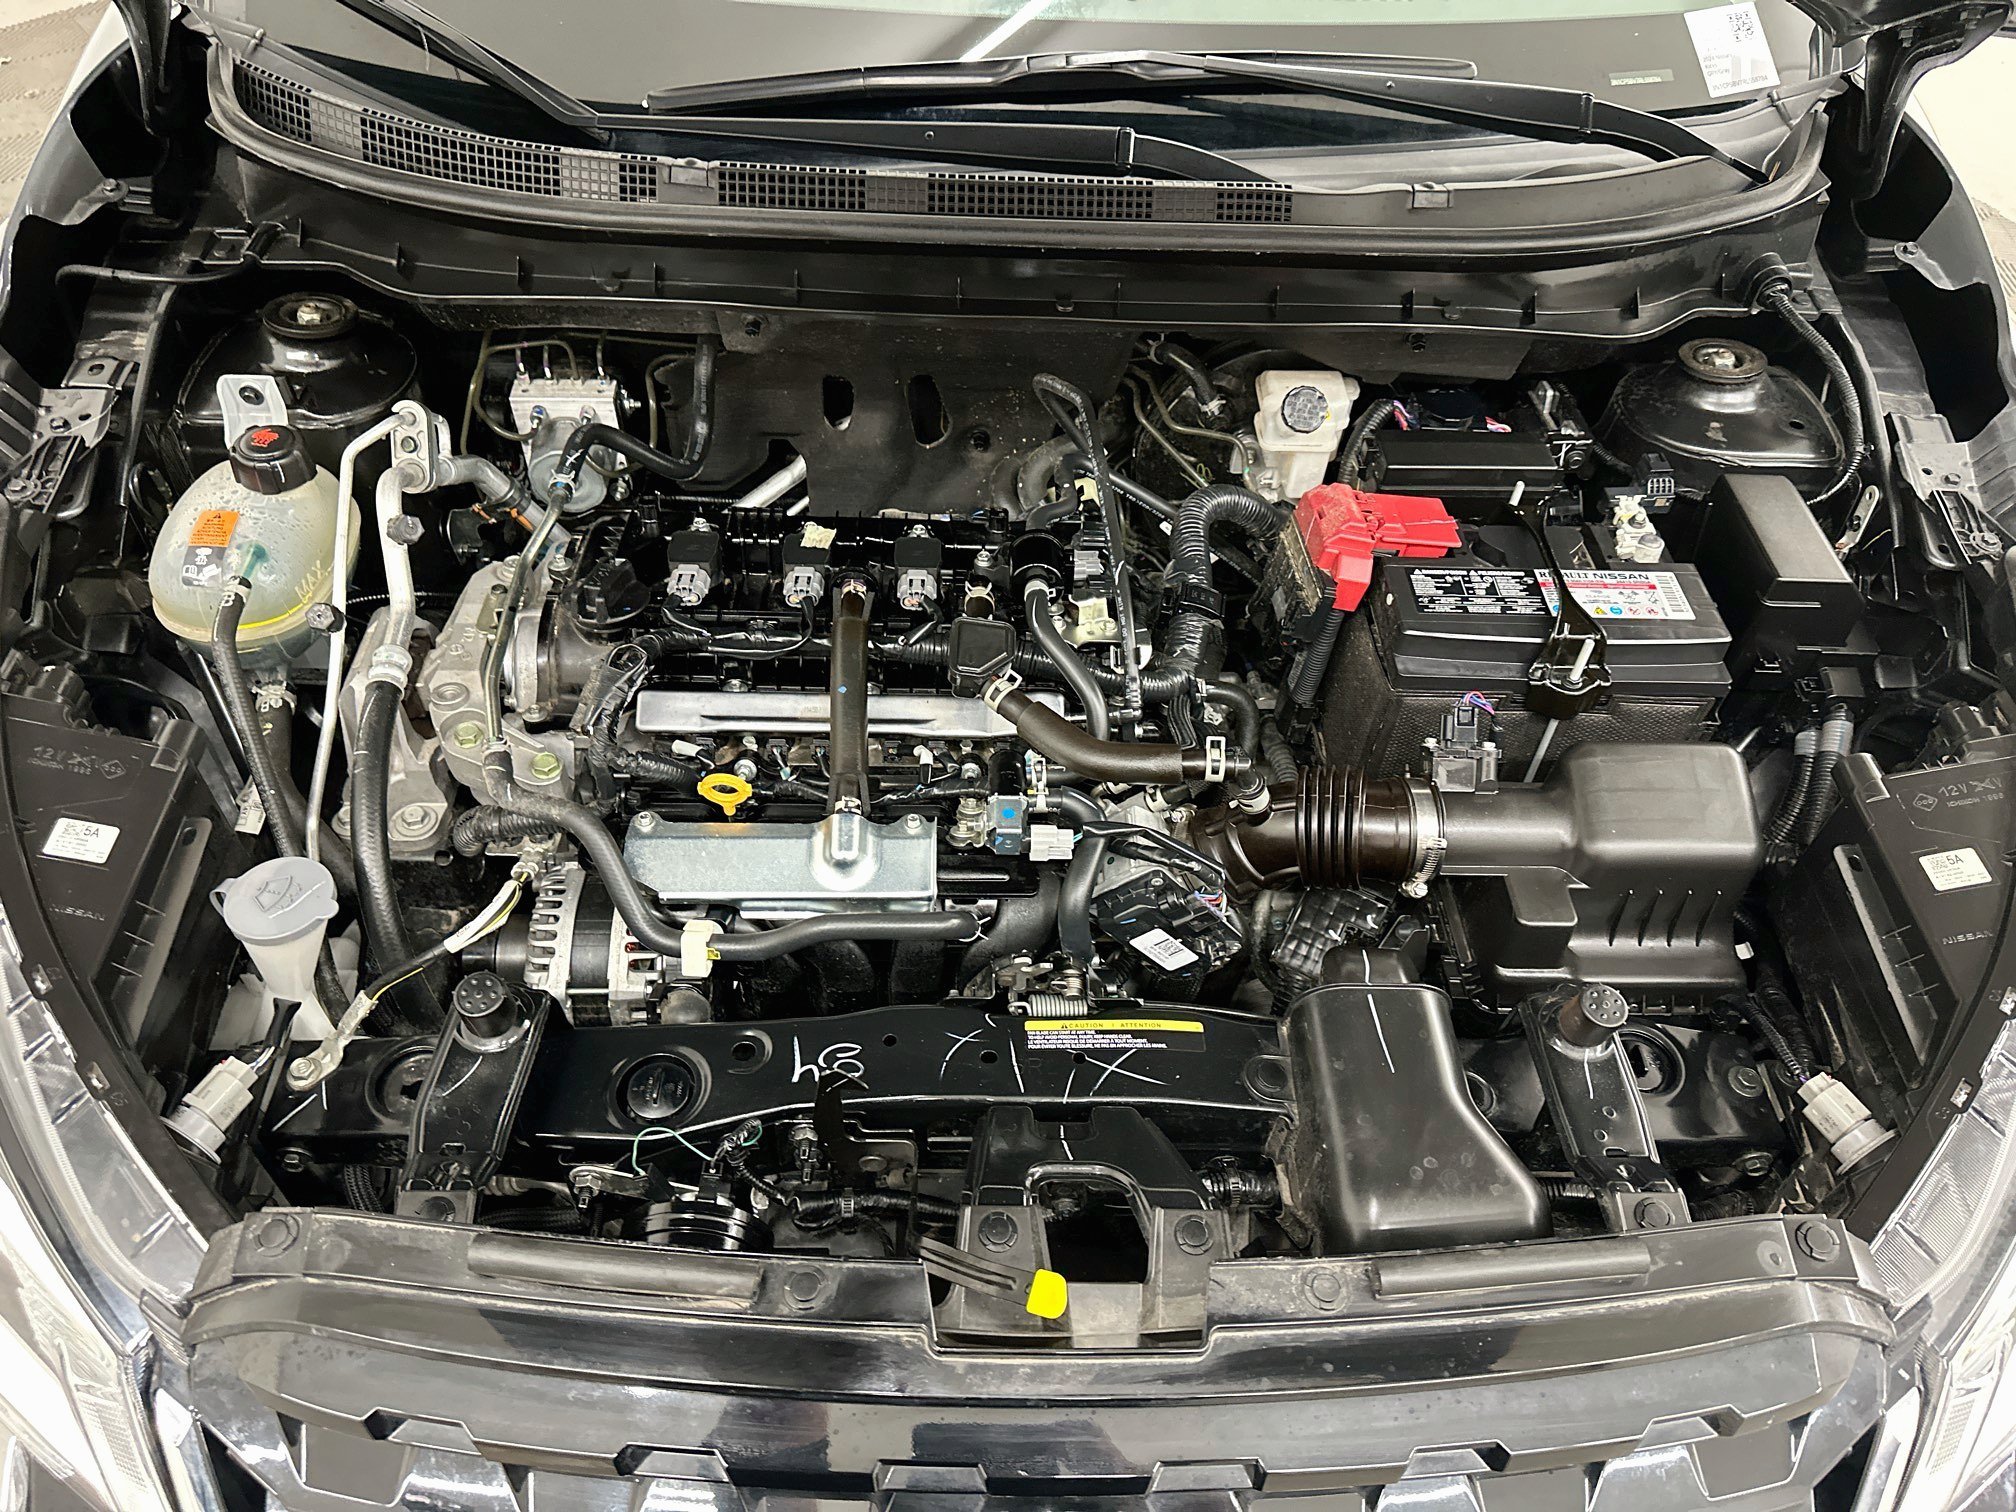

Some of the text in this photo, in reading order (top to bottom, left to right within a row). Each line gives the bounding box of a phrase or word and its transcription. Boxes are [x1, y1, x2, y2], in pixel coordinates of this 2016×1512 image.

[294, 560, 323, 600] MAX
[1593, 572, 1650, 580] NISSAN
[1938, 783, 1968, 798] 12V
[83, 825, 100, 838] 5A
[1946, 854, 1964, 866] 5A
[1942, 929, 1994, 946] NISSAN
